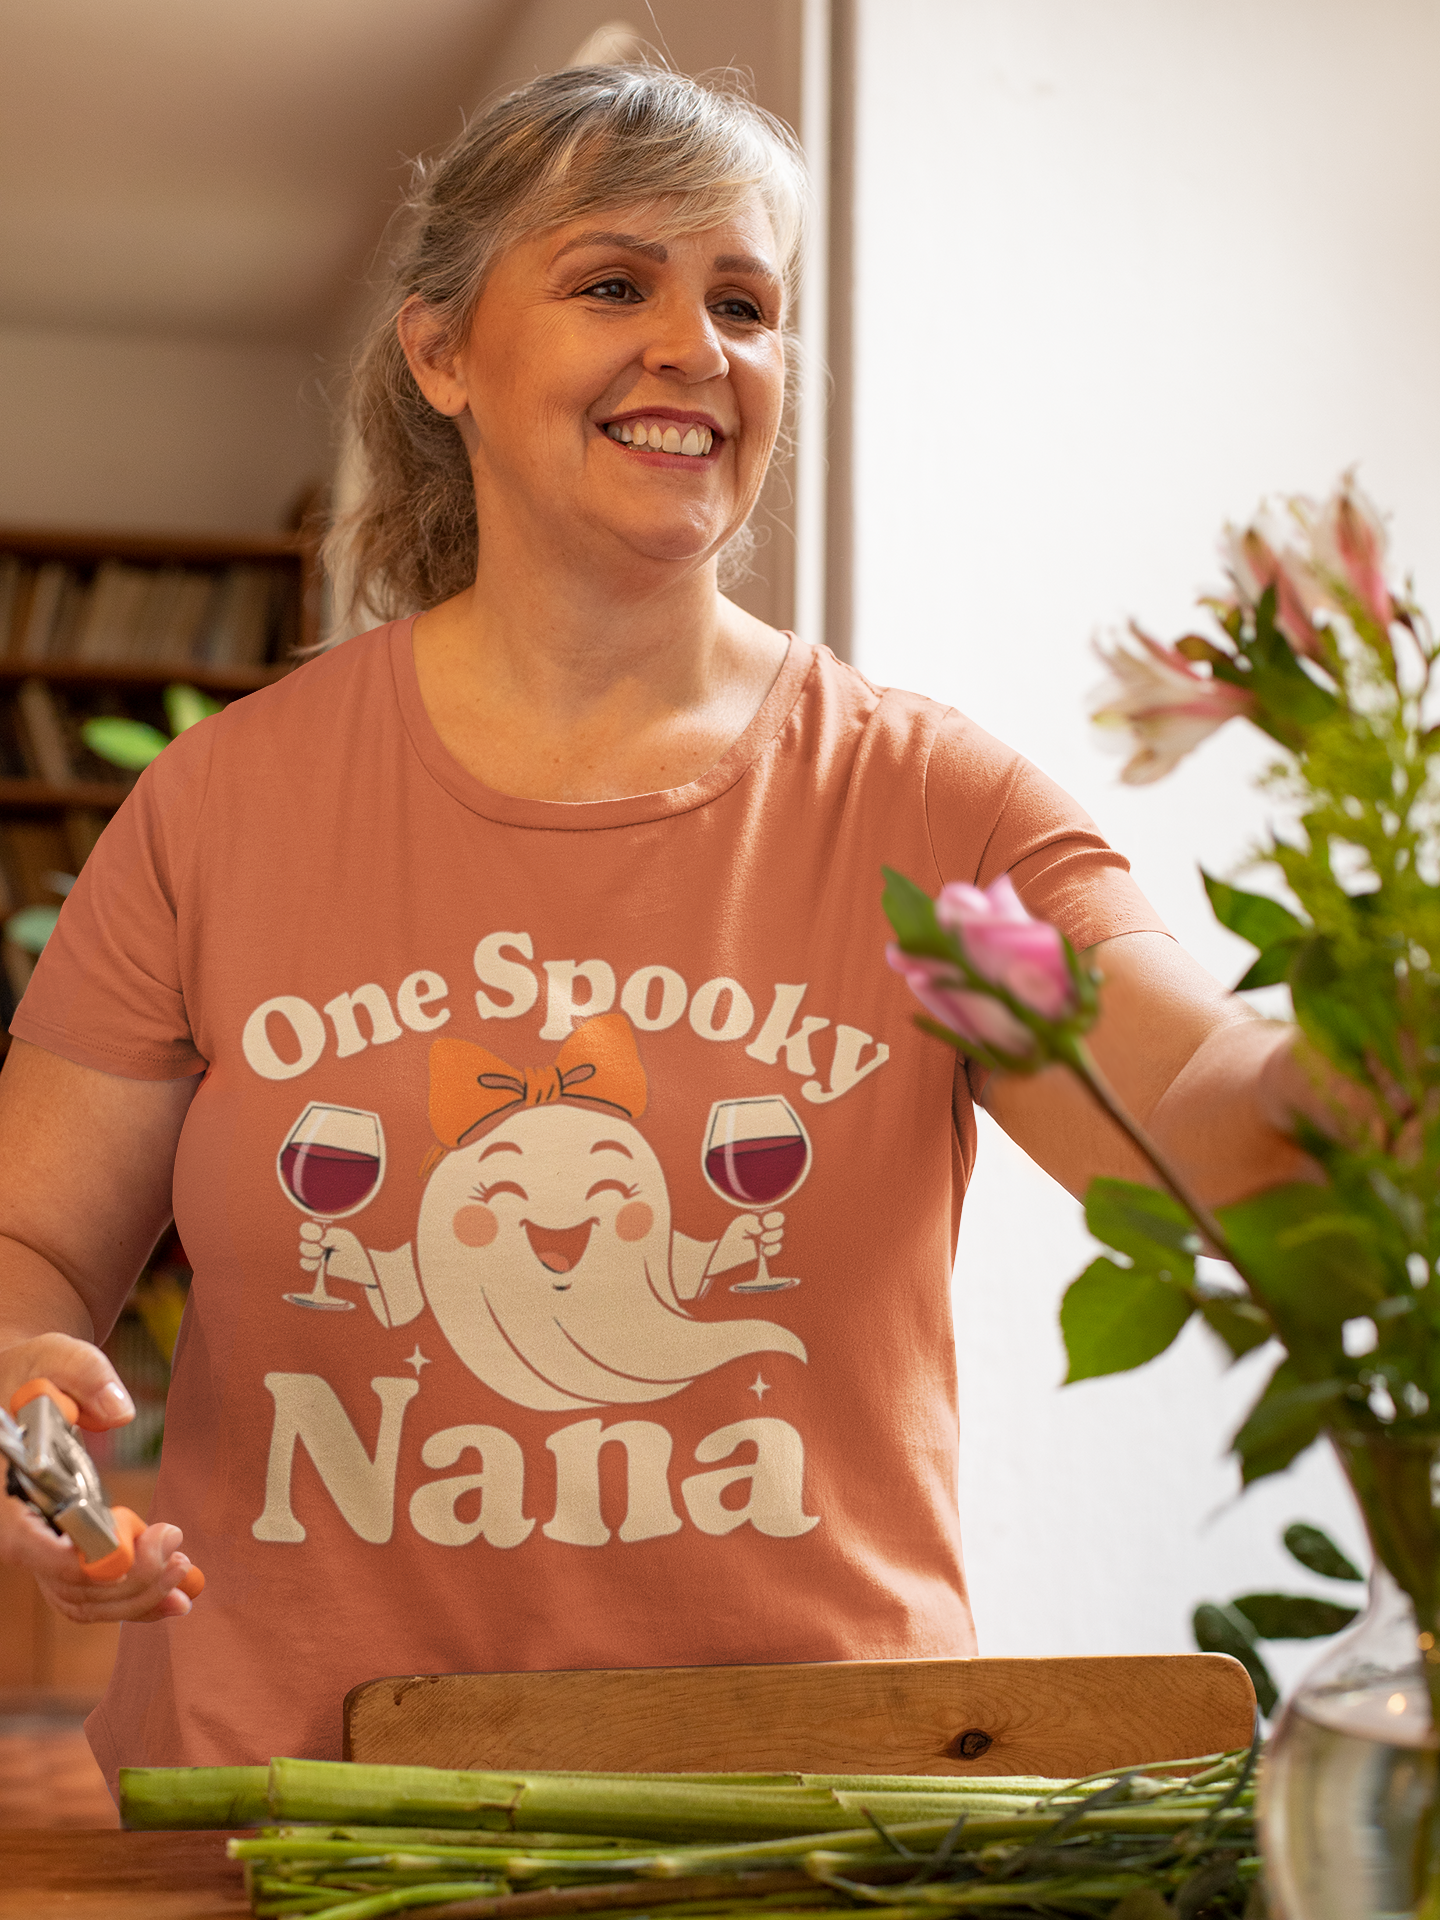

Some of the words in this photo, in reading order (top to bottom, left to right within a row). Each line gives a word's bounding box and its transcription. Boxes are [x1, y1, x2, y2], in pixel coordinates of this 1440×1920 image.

[242, 970, 451, 1080] One
[473, 931, 890, 1104] Spooky
[251, 1371, 821, 1549] Nana
